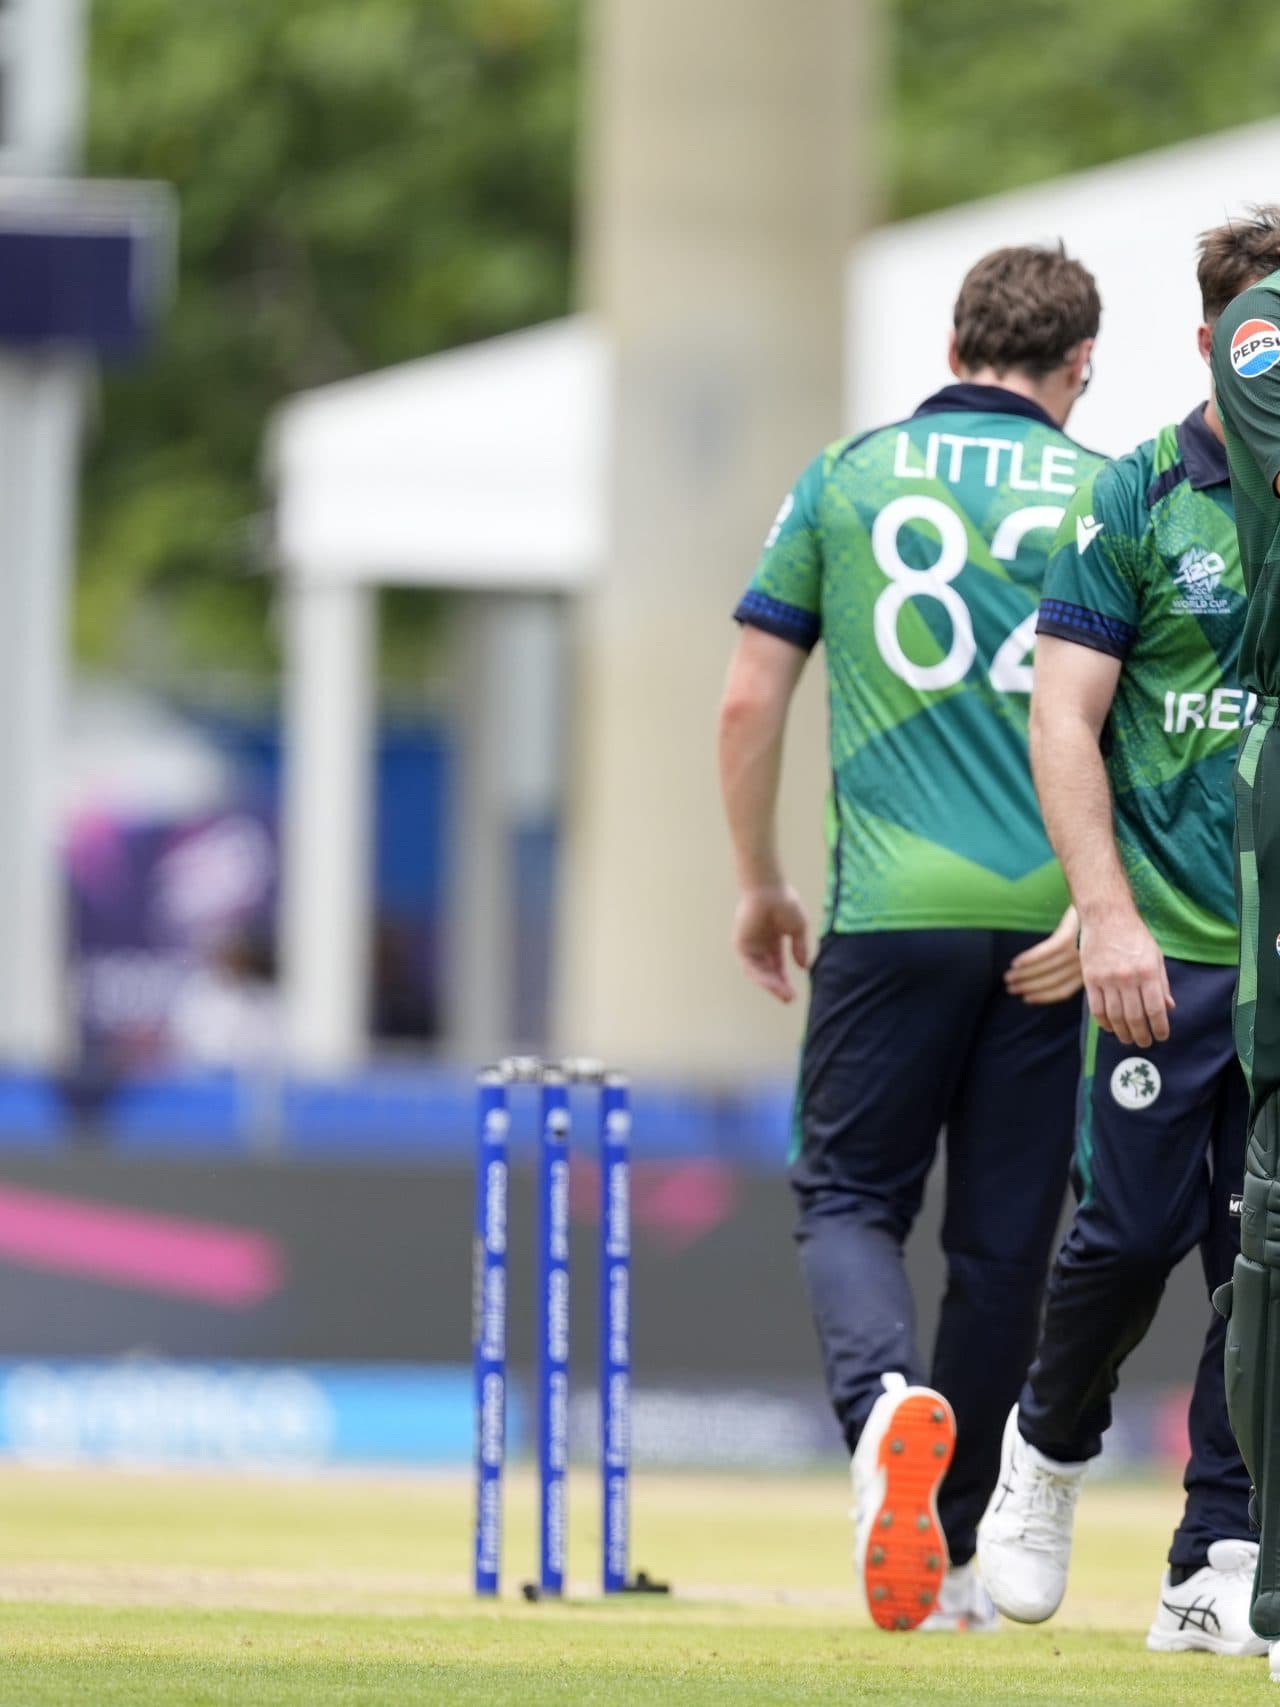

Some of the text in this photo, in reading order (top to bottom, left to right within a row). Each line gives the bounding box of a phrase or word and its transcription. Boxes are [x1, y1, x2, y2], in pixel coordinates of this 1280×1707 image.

[1233, 337, 1280, 364] PEPSI
[893, 431, 1077, 495] LITTLE
[872, 495, 1066, 692] 82
